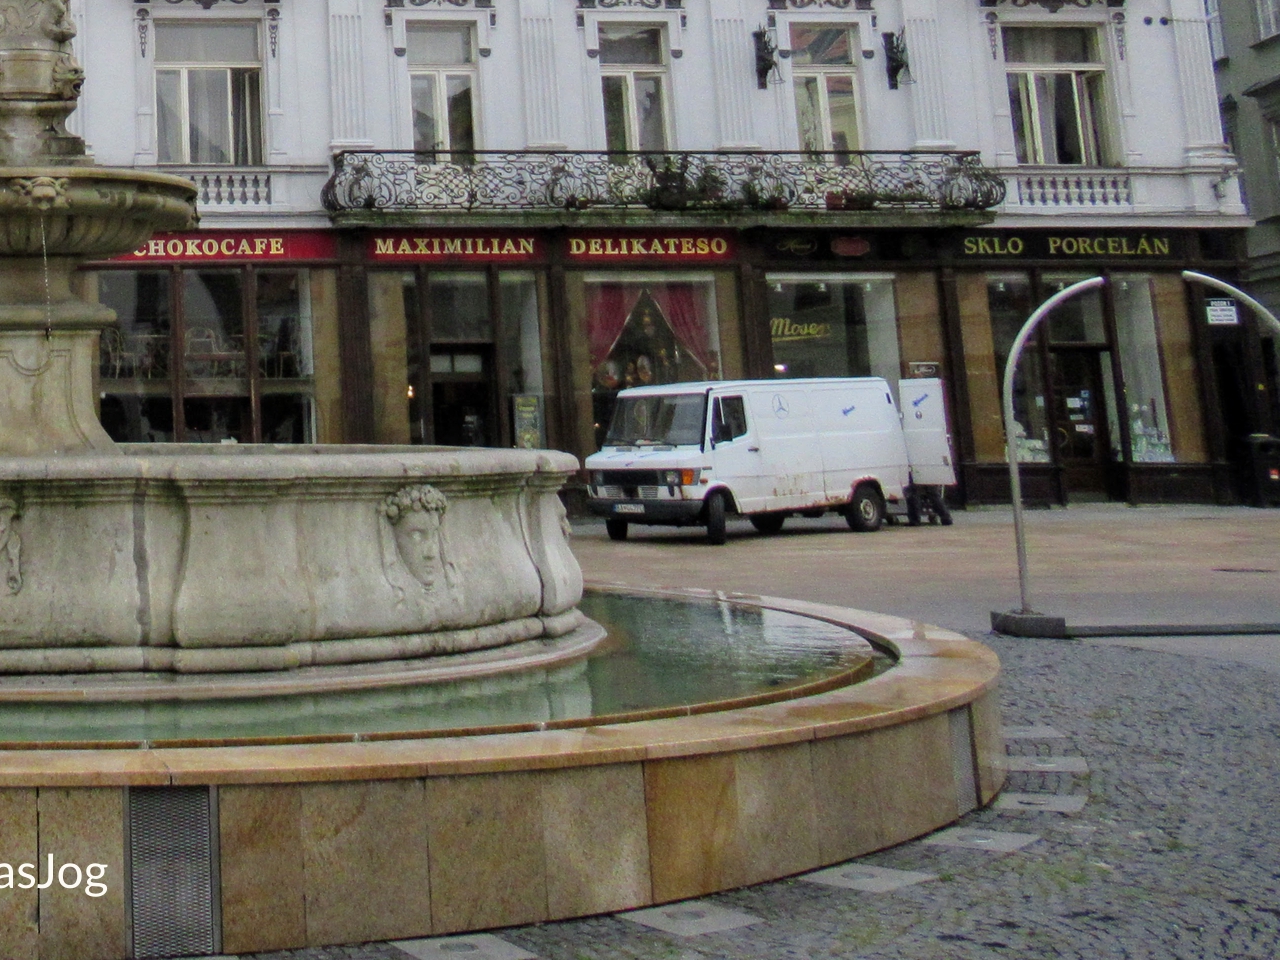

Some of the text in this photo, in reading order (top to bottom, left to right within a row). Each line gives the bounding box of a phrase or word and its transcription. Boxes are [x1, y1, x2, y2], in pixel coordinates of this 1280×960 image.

[375, 237, 536, 254] MAXIMILIAN
[569, 238, 728, 255] DELIKATESO
[964, 234, 1169, 255] SKLO PORCELÁN
